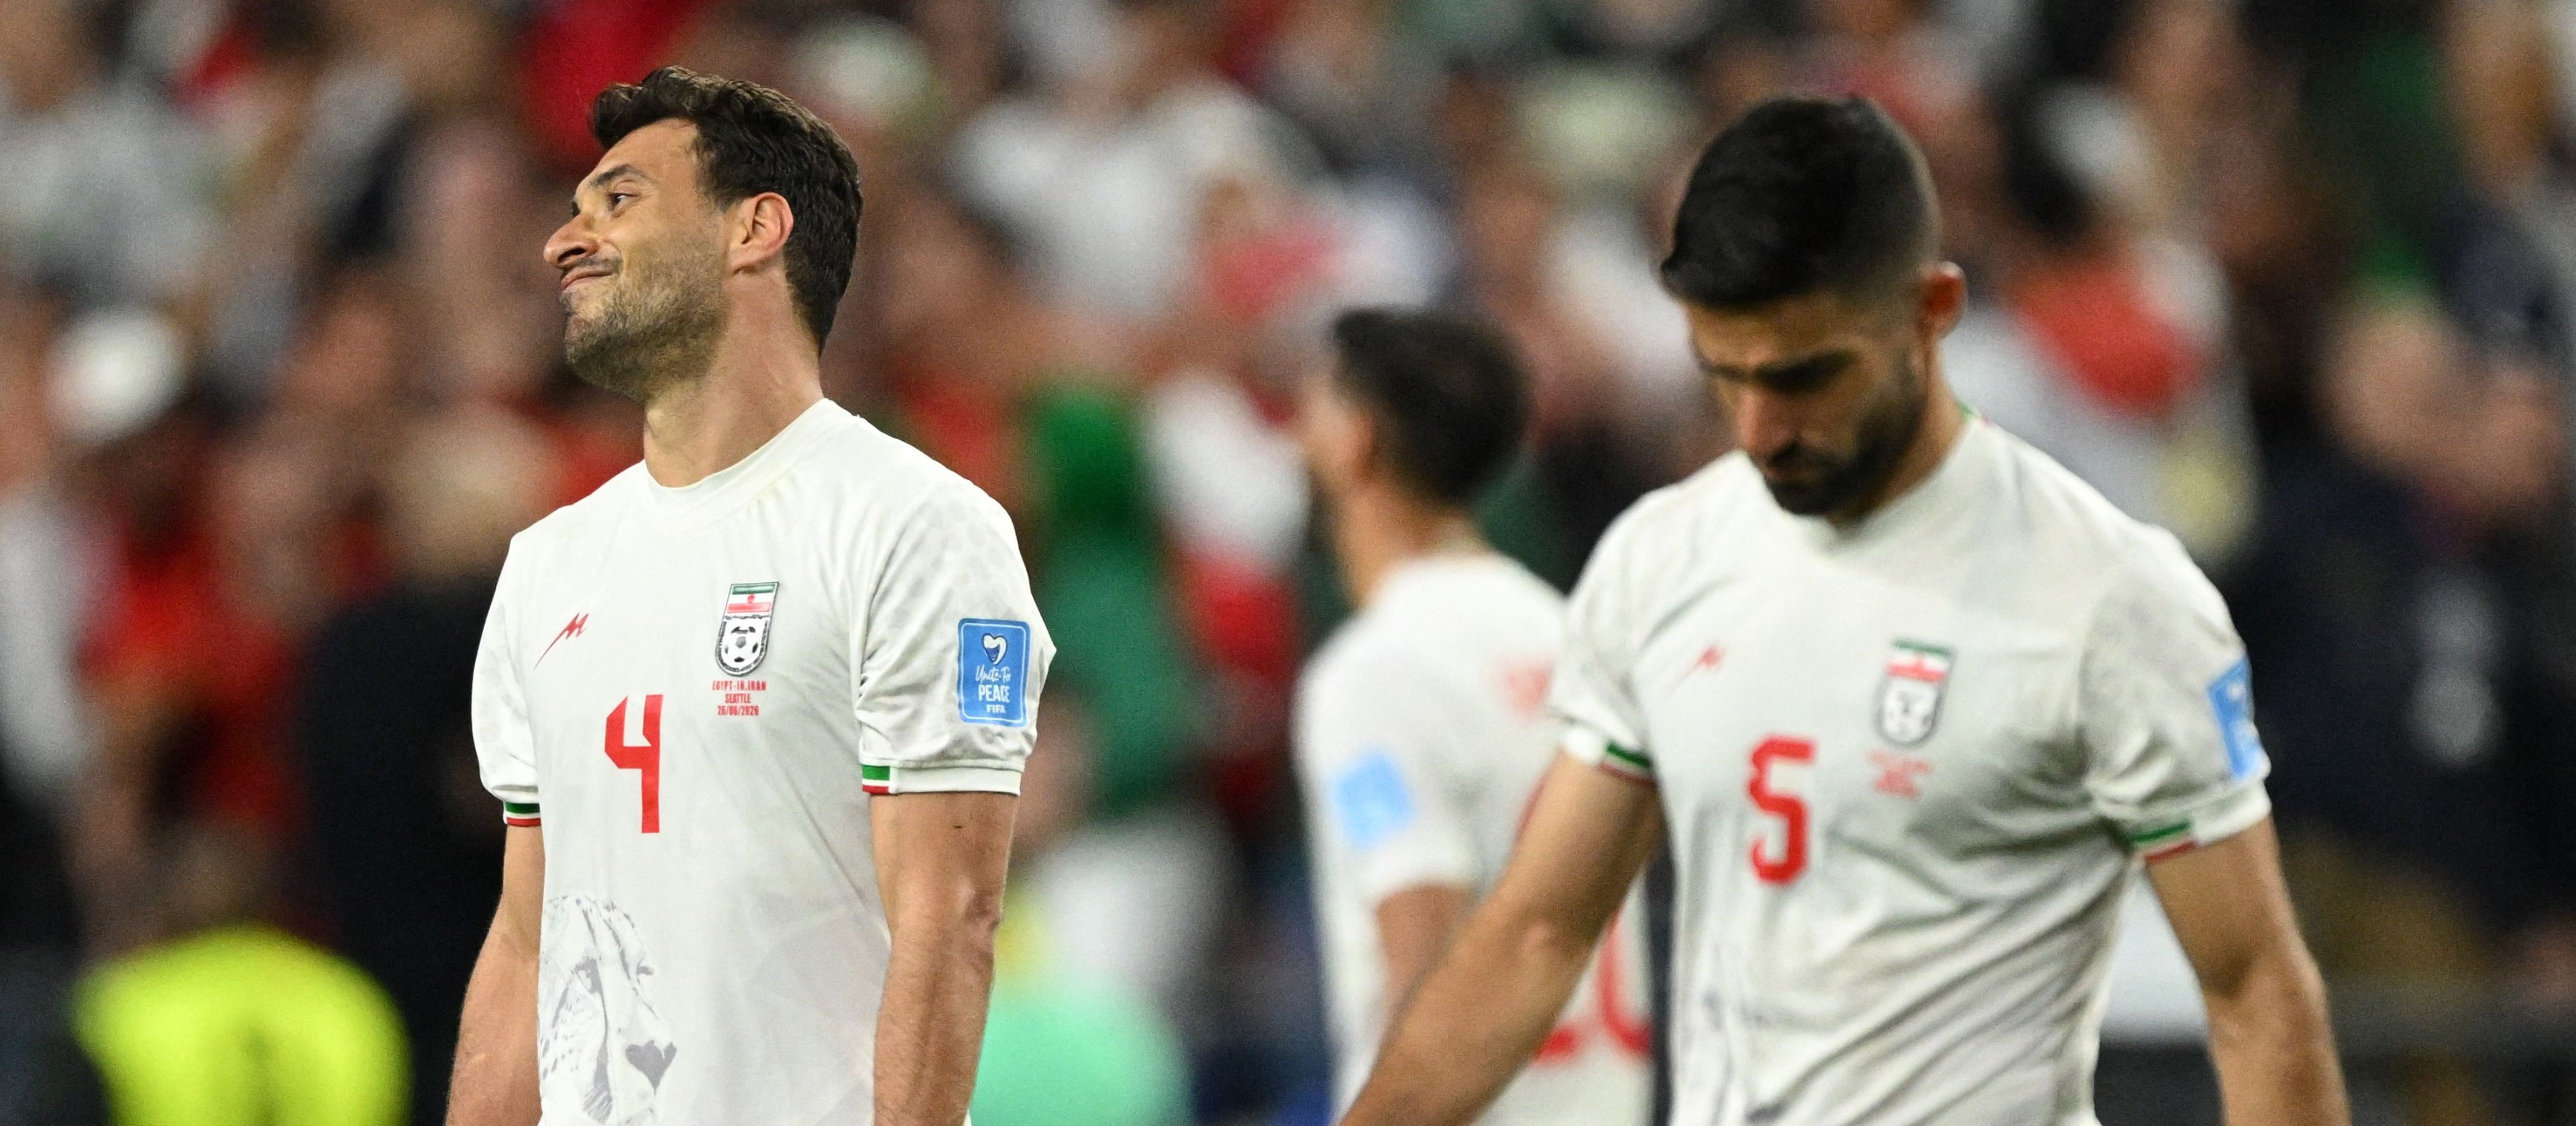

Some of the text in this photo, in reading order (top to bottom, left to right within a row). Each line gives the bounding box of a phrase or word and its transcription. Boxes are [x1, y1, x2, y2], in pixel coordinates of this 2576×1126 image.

[725, 693, 751, 703] SEATTLE
[978, 684, 1010, 703] PEACE
[717, 705, 759, 716] 26/06/2026
[986, 704, 1006, 714] FIFA
[604, 694, 663, 834] 4
[1747, 734, 1817, 886] 5
